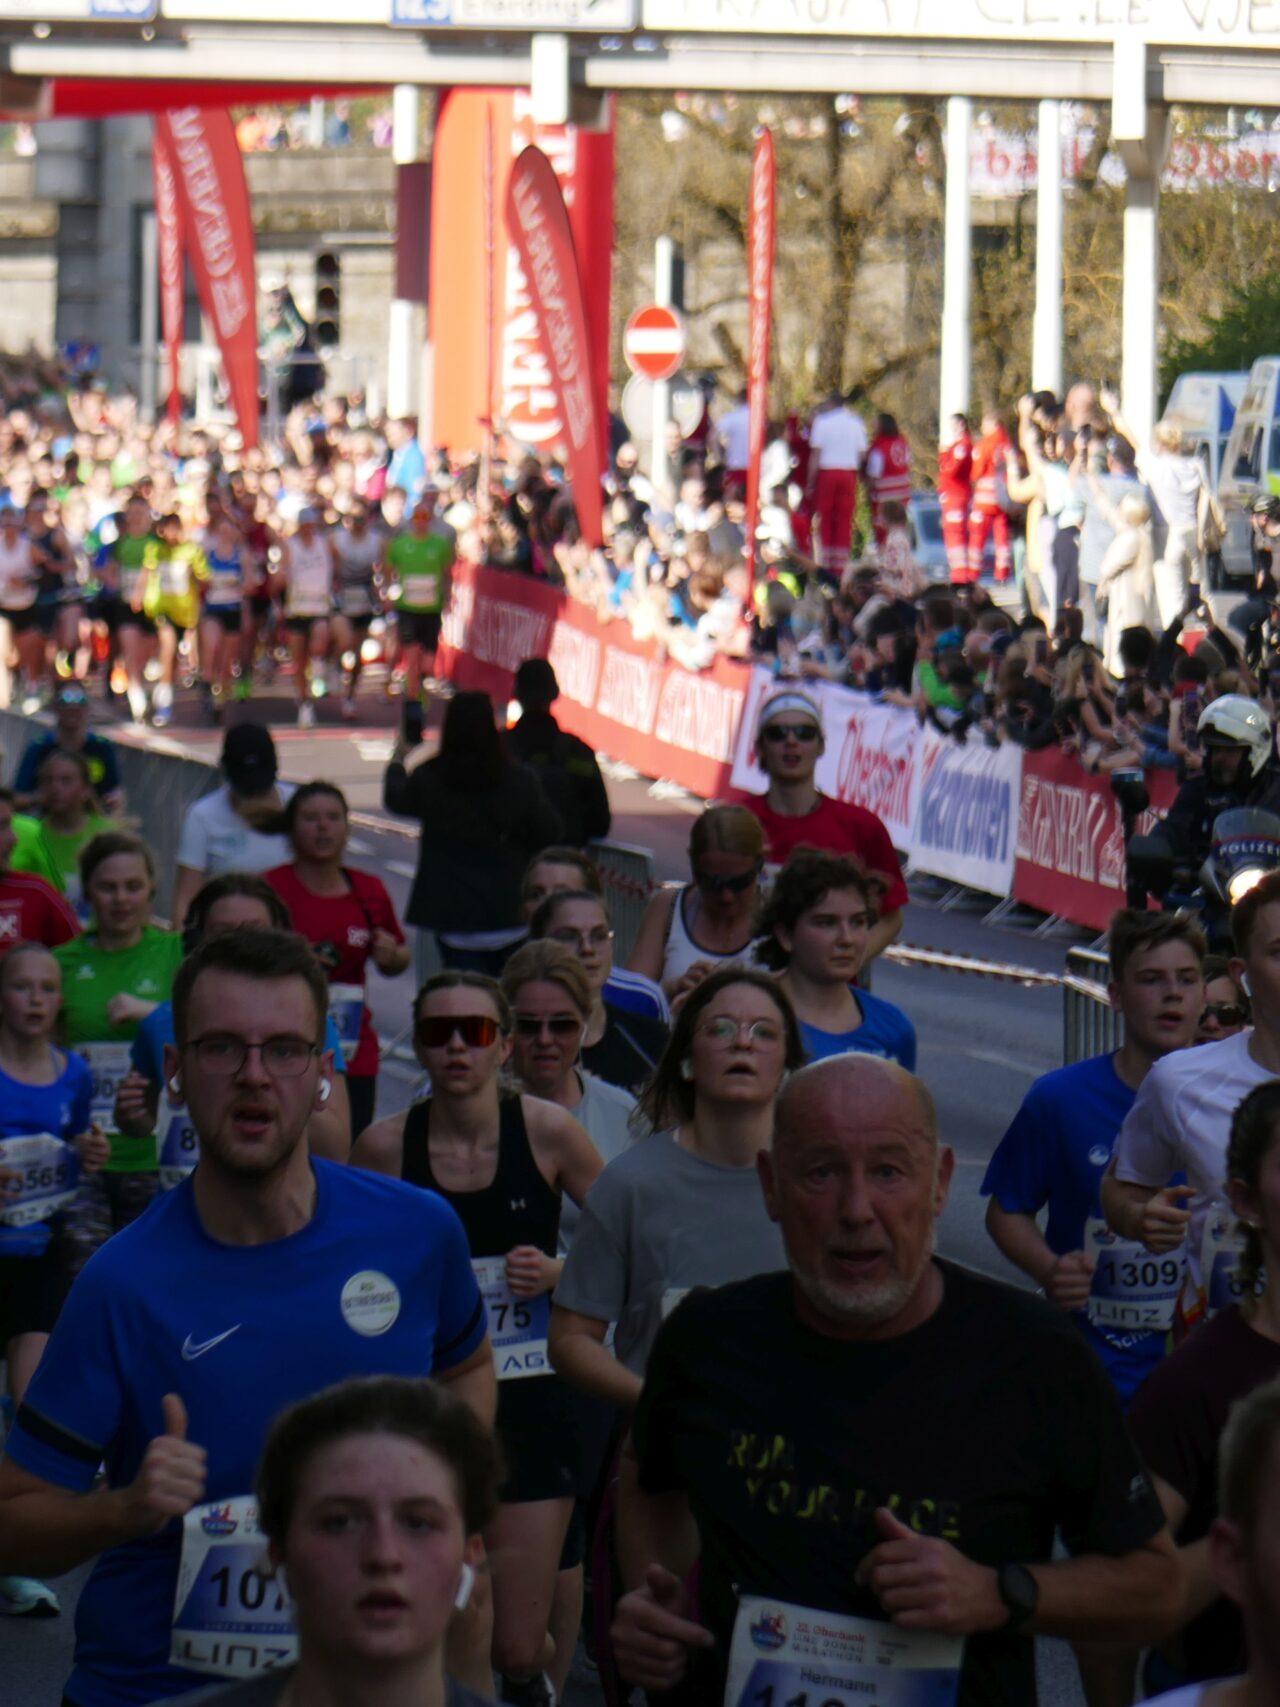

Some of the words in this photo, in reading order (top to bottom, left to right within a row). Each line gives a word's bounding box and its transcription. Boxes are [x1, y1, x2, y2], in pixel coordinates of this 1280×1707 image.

[1104, 1257, 1188, 1288] 1309
[502, 1352, 545, 1373] AG
[812, 1625, 866, 1643] Oberbank
[799, 1667, 878, 1694] Hermann
